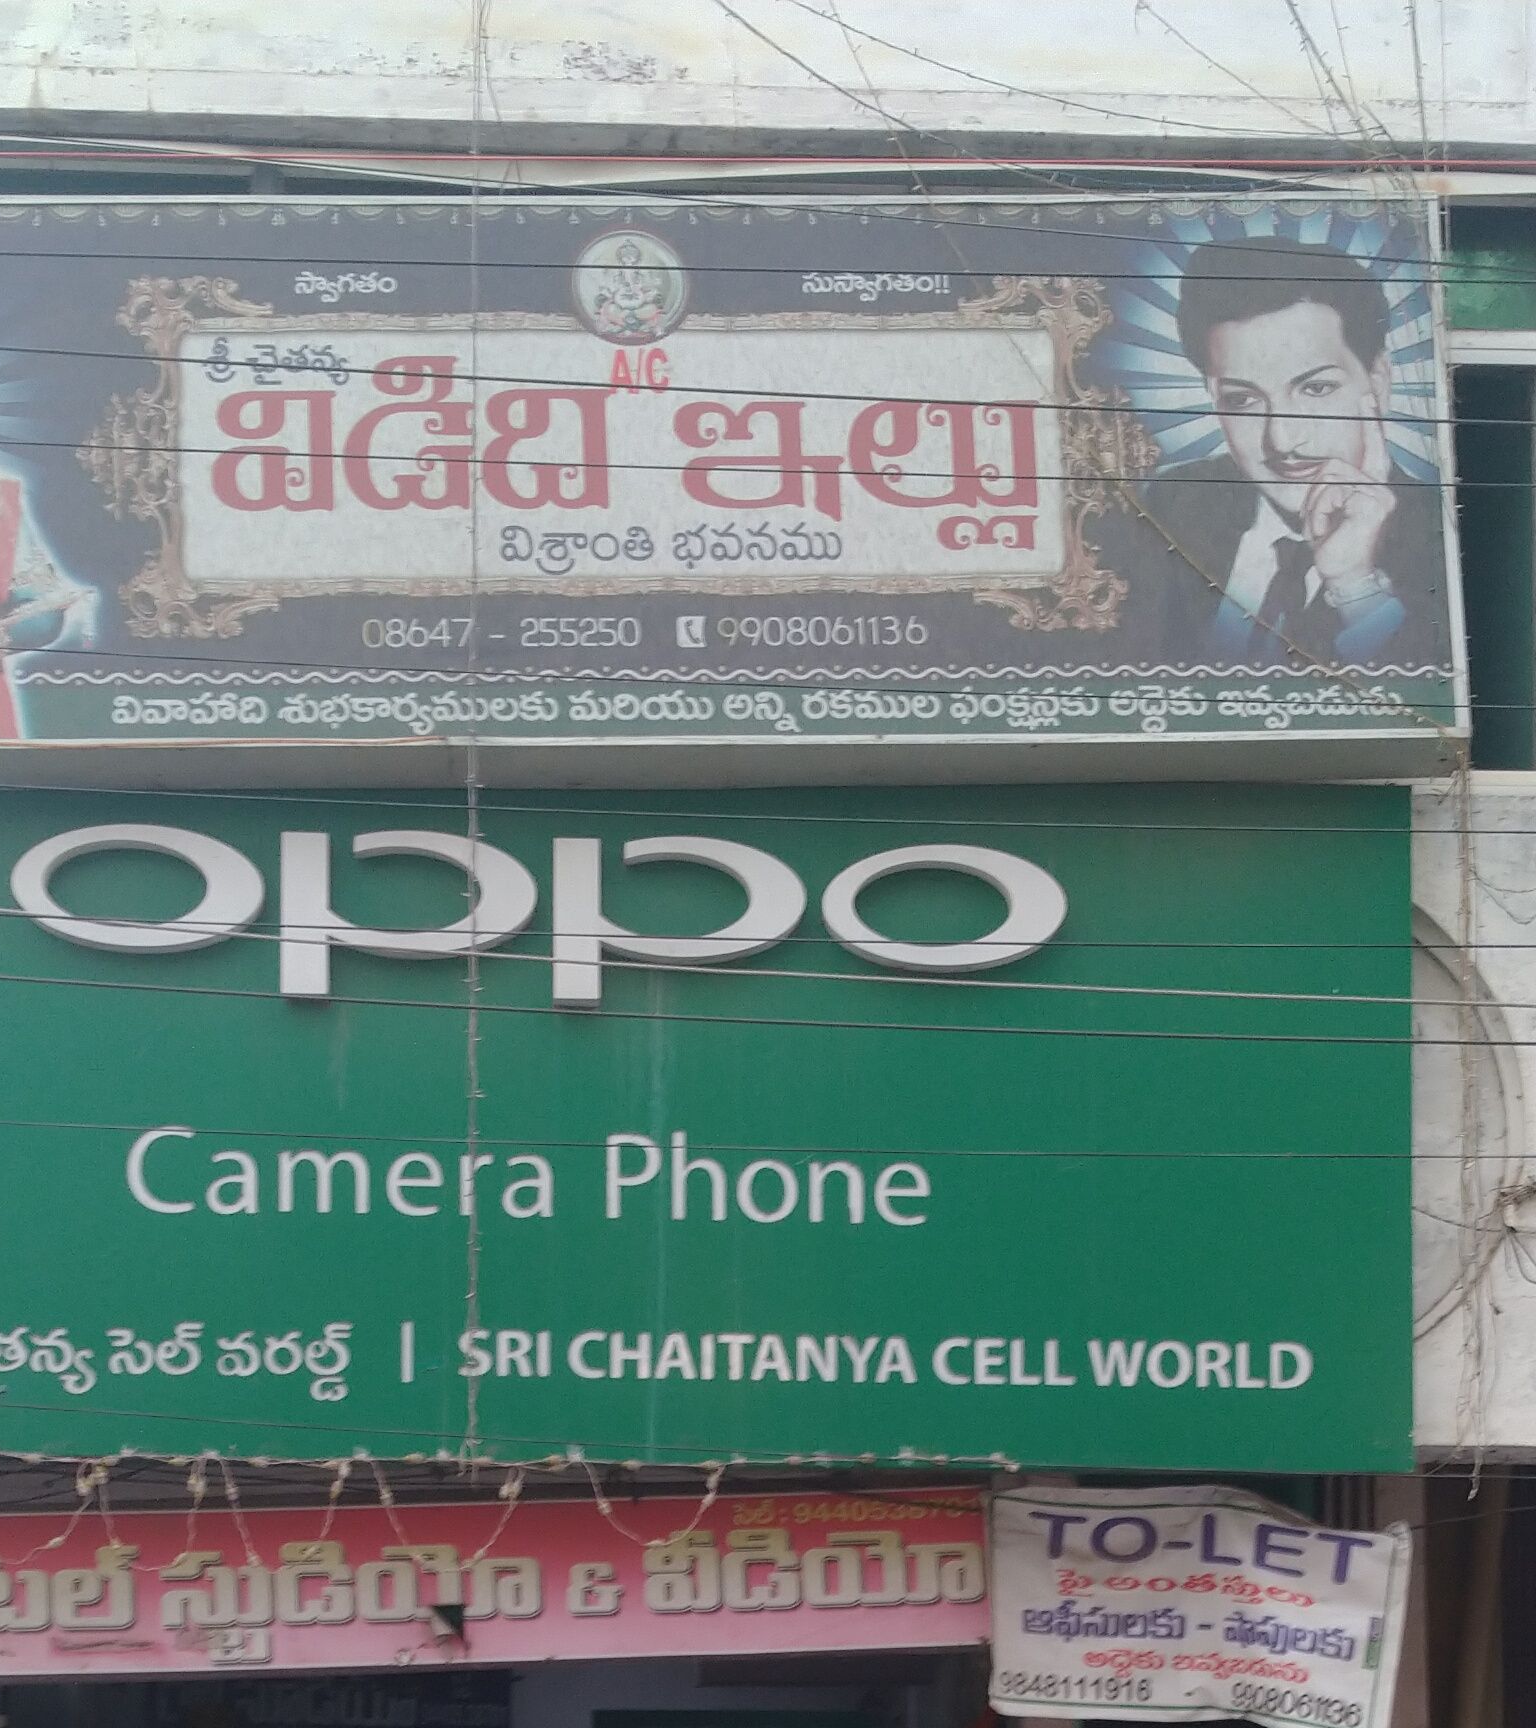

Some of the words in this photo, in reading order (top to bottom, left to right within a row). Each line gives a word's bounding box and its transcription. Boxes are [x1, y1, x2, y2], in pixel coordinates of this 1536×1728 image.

[294, 271, 398, 298] స్వాగతం
[202, 336, 237, 384] శ్రీ
[246, 343, 351, 386] చైతన్య
[610, 347, 670, 394] A/C
[500, 523, 657, 576] విశ్రాంతి
[672, 522, 843, 565] భవనము
[361, 616, 471, 650] 08647
[520, 616, 642, 649] 255250
[717, 615, 929, 648] 9908061136
[110, 693, 265, 726] వివాహాది
[568, 691, 714, 723] మరియు
[723, 689, 801, 733] అన్ని
[802, 688, 941, 721] రకముల
[126, 1125, 555, 1219] Camera
[605, 1130, 932, 1227] Phone
[107, 1321, 206, 1378] సెల్
[457, 1328, 553, 1380] SRI
[567, 1328, 919, 1386] CHAITANYA
[932, 1335, 1078, 1388] CELL
[1088, 1337, 1315, 1391] WORLD
[1030, 1512, 1373, 1586] TO-LET
[568, 1561, 626, 1617] &
